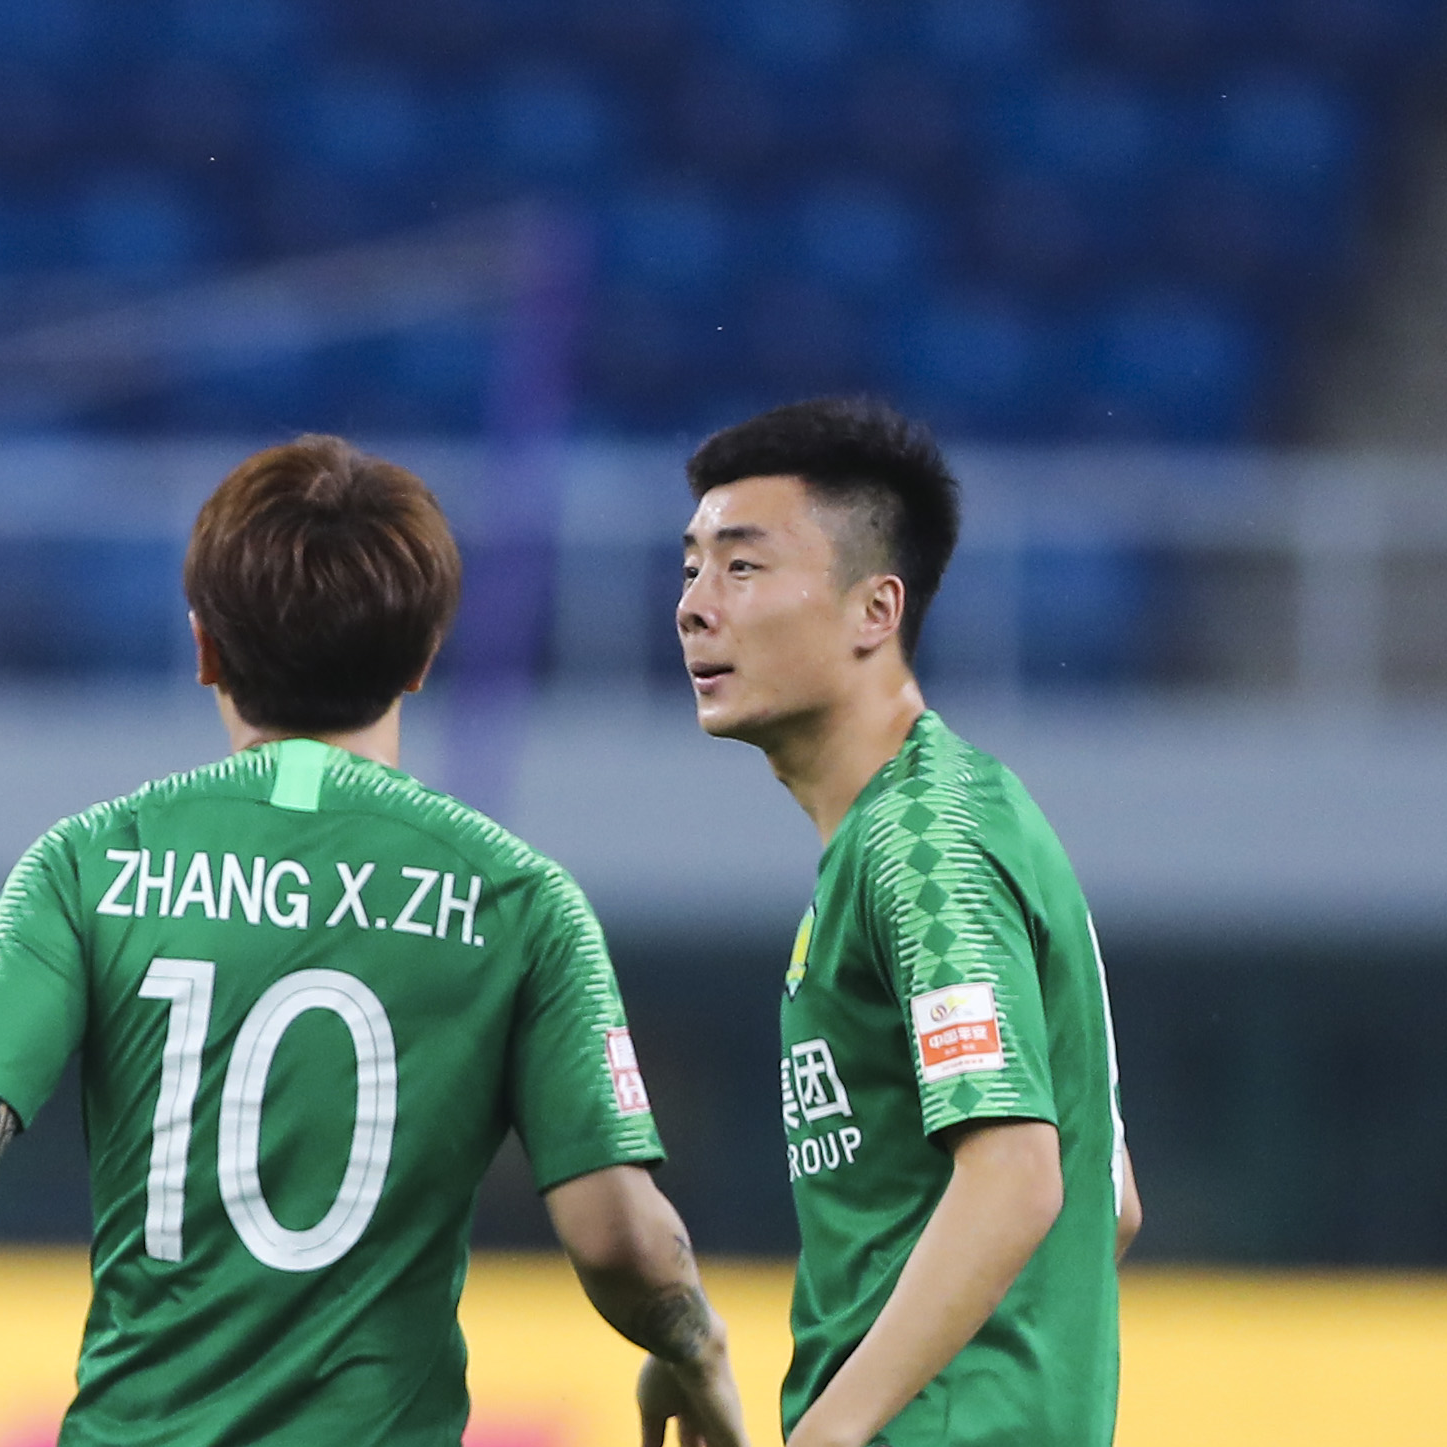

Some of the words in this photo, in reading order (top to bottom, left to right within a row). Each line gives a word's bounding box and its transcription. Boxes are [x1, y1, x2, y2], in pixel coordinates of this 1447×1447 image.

[96, 848, 310, 930] ZHANG
[325, 862, 486, 948] X.ZH.
[138, 957, 399, 1273] 10
[787, 1126, 862, 1183] ROUP
